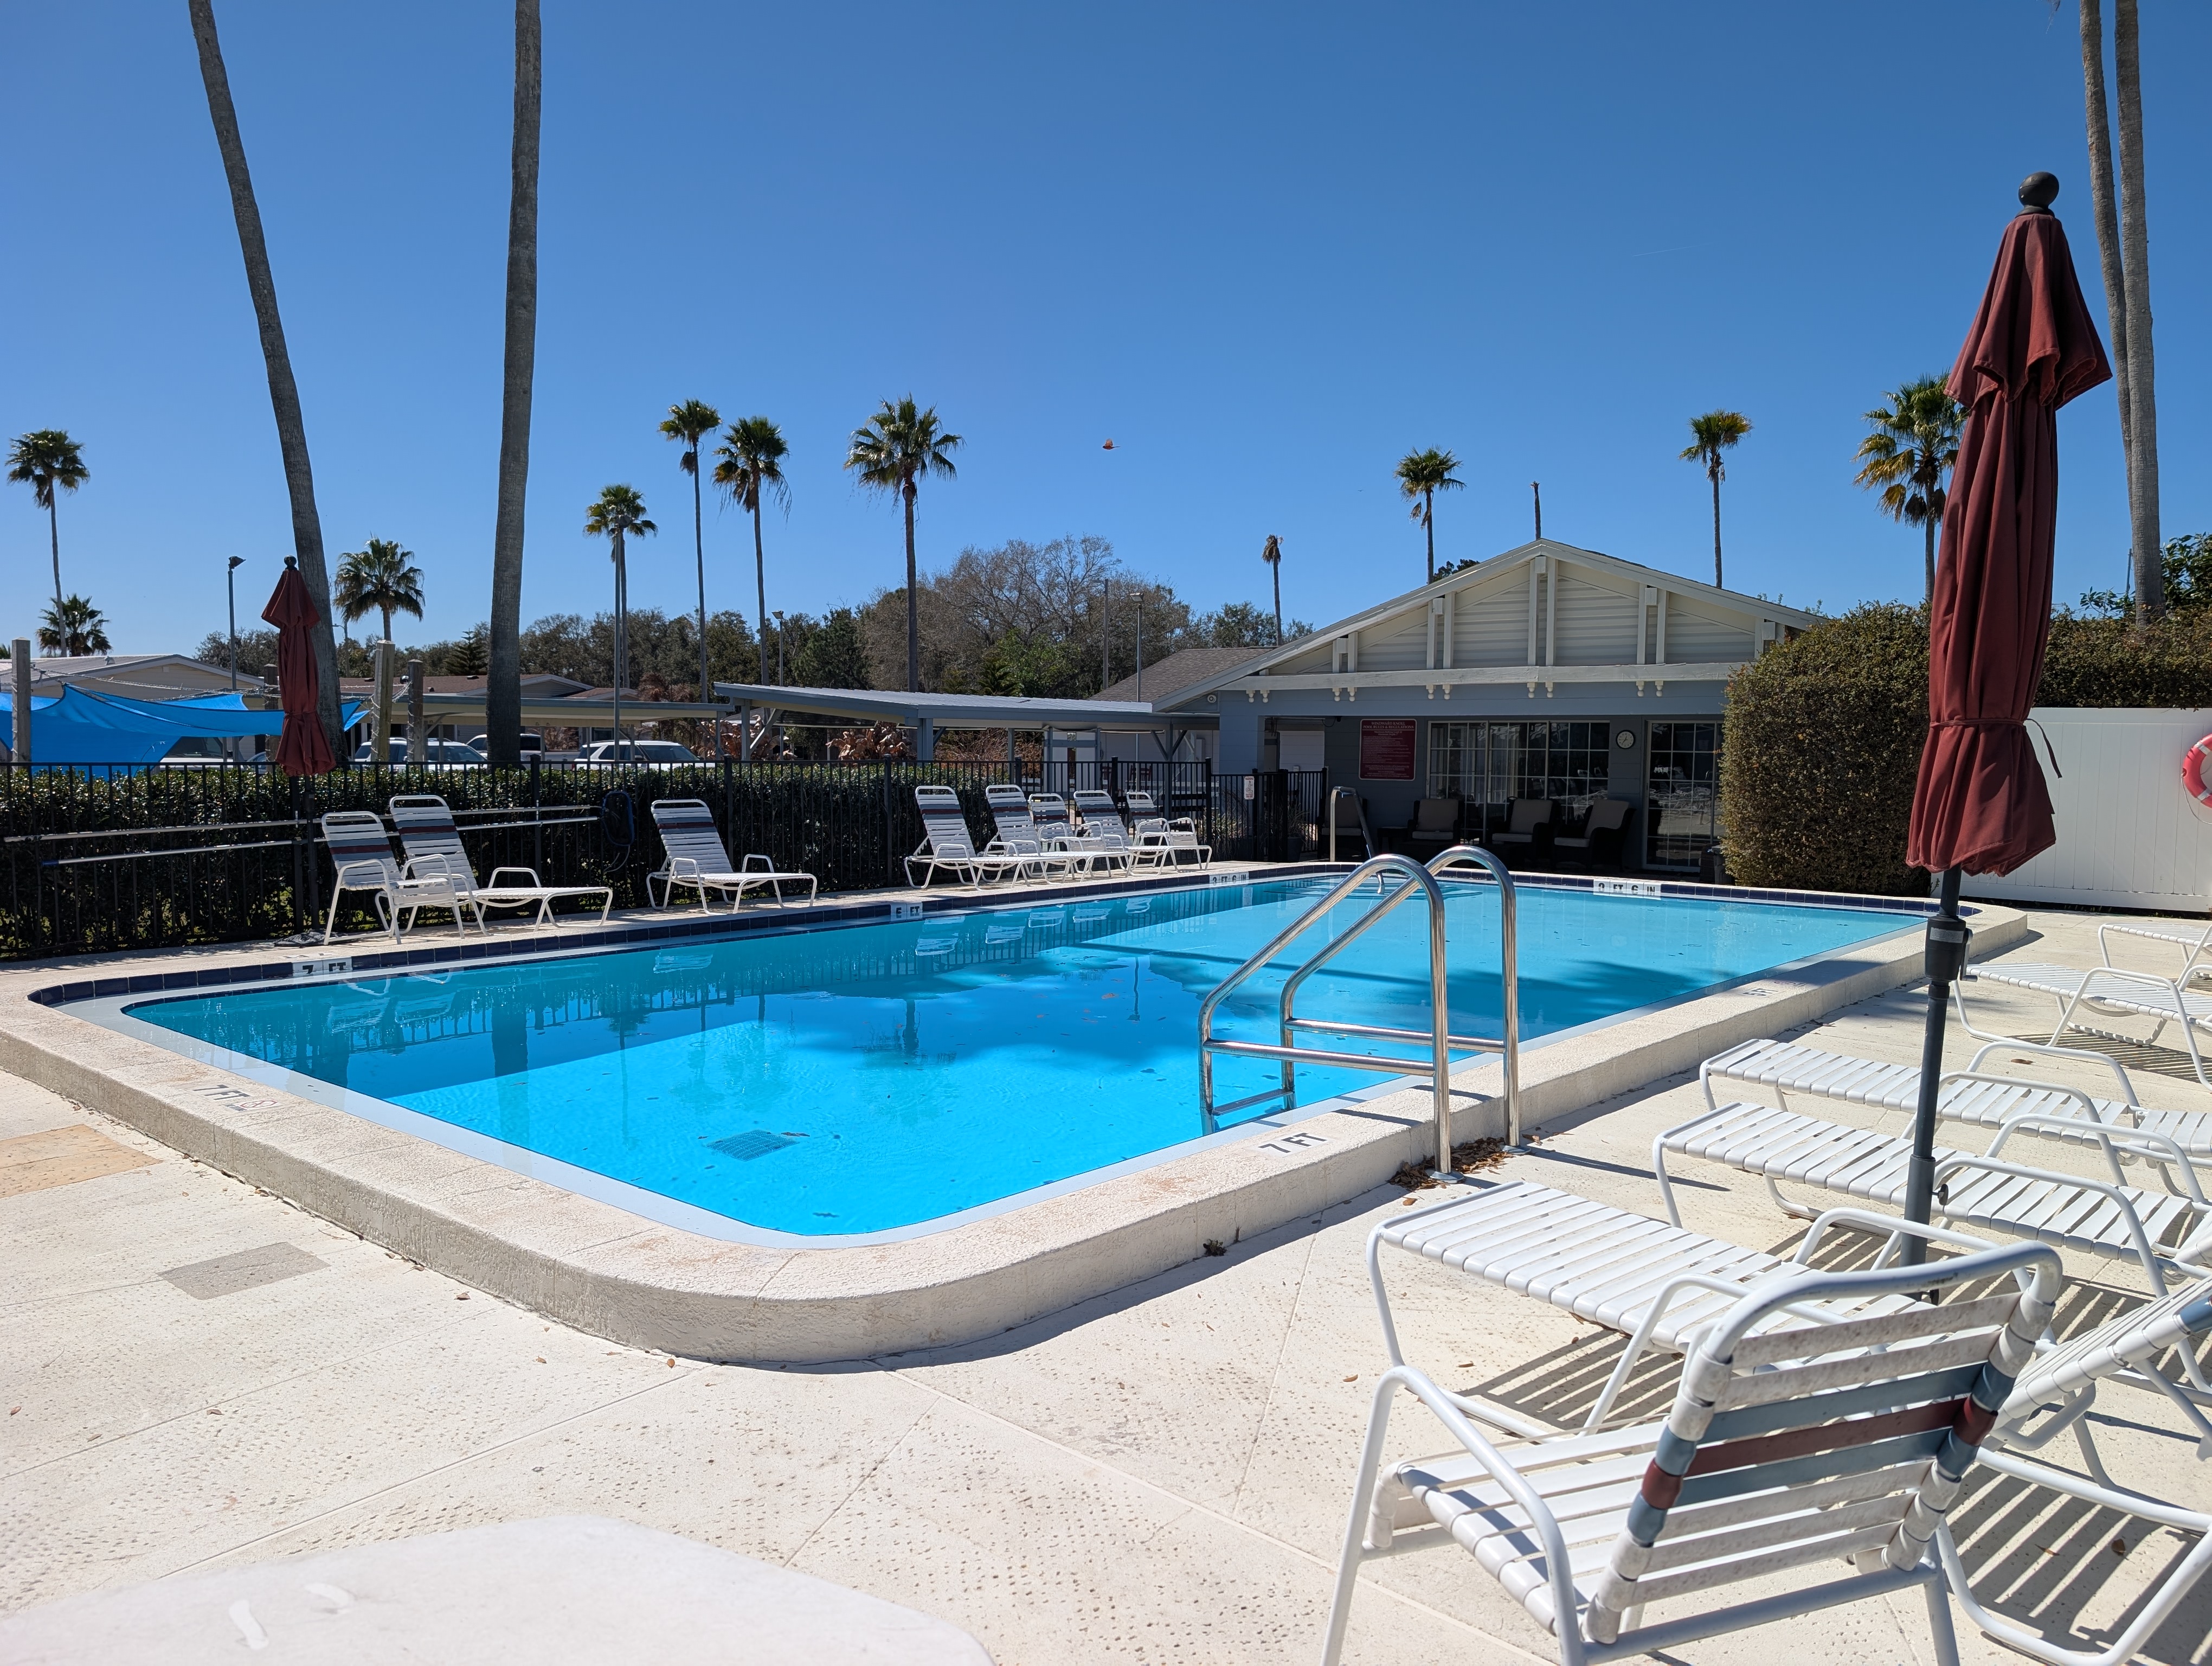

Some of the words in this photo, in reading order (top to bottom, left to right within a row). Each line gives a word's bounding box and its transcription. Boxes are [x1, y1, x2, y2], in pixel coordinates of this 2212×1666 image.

[1631, 885, 1639, 893] 6
[910, 906, 920, 914] FT
[302, 964, 314, 974] 7
[329, 962, 346, 972] FT
[204, 1090, 251, 1100] FT
[1258, 1143, 1291, 1154] 7
[1281, 1132, 1328, 1147] FT
